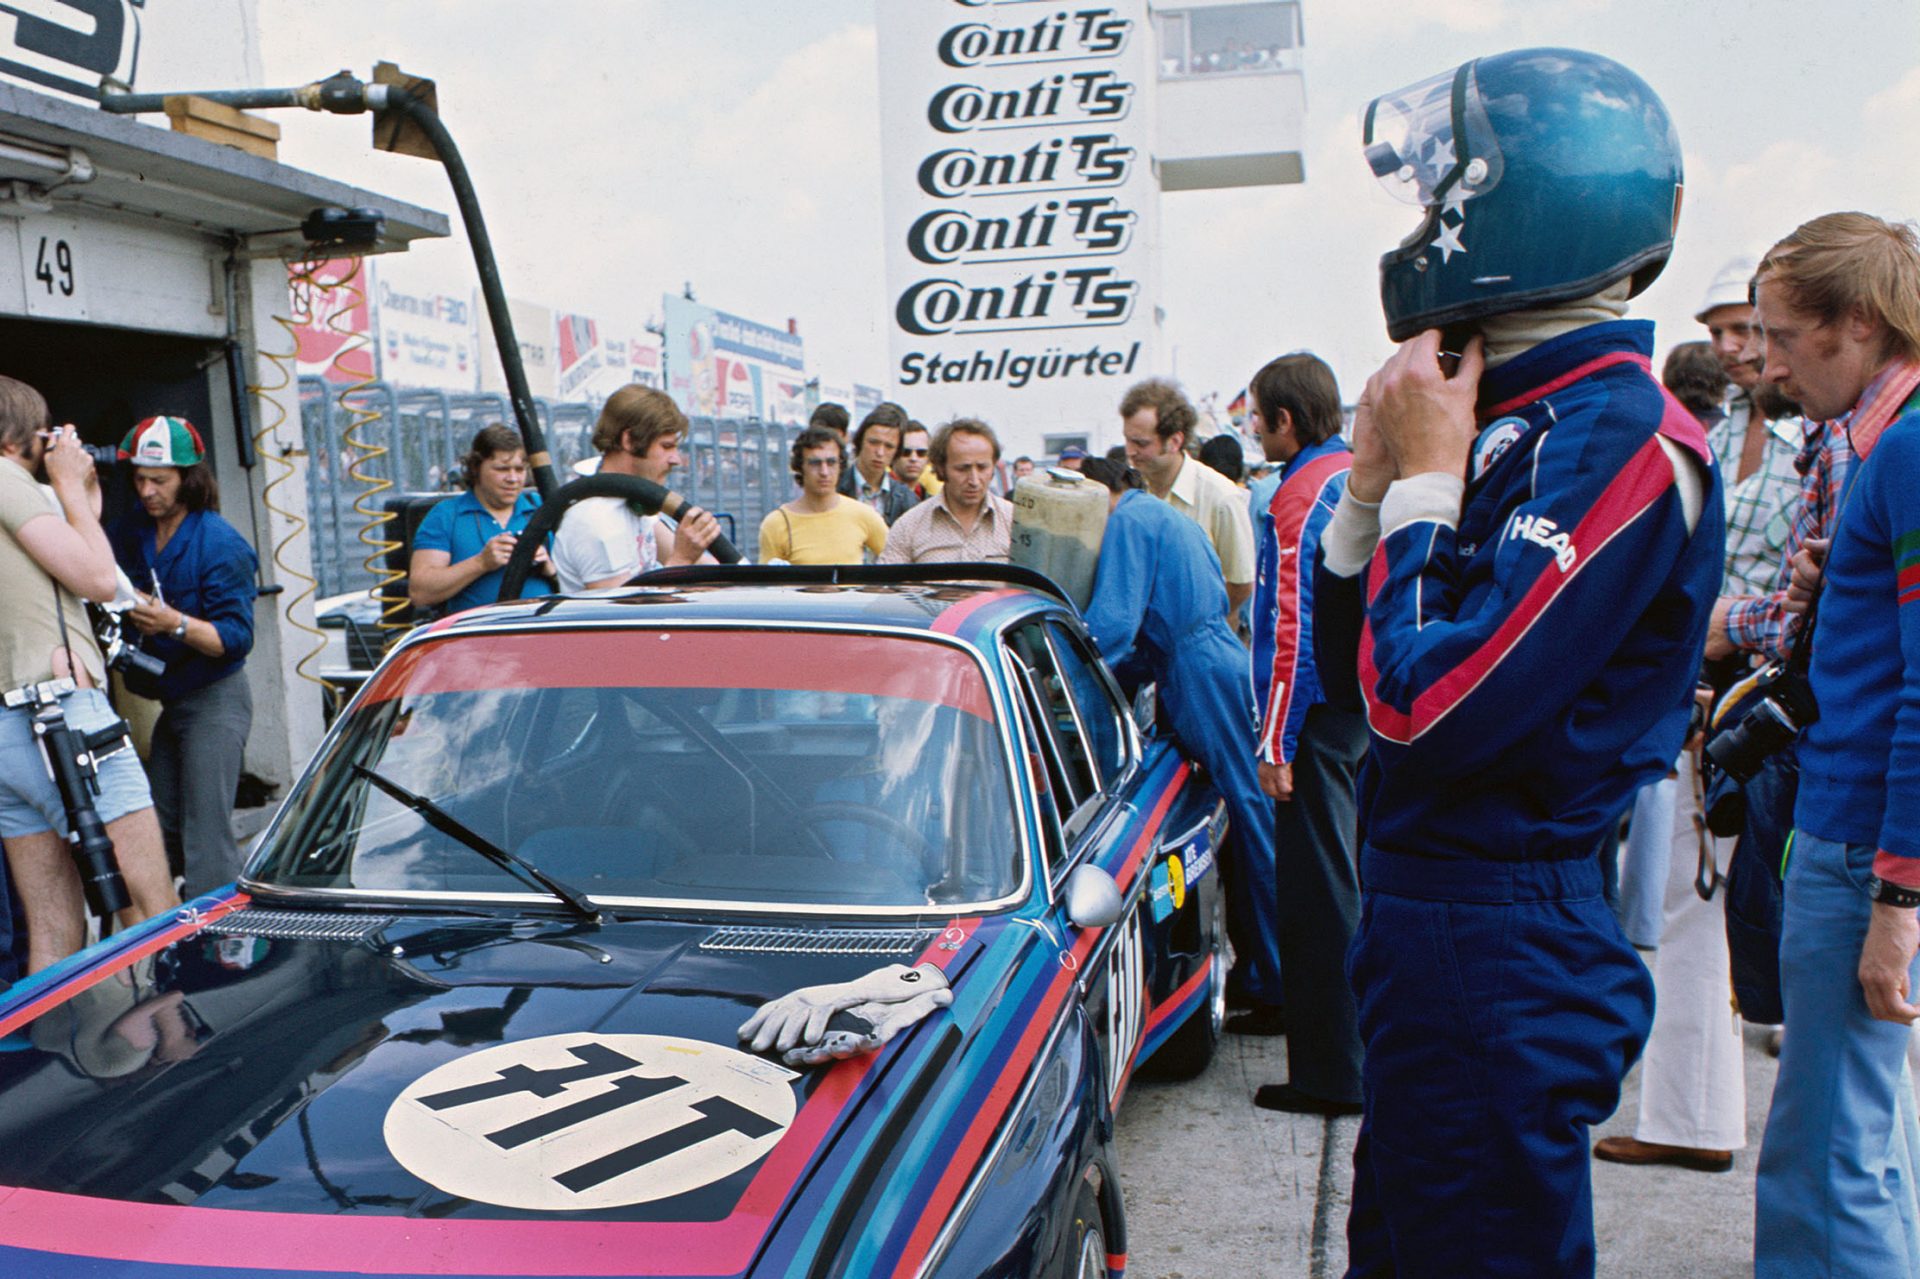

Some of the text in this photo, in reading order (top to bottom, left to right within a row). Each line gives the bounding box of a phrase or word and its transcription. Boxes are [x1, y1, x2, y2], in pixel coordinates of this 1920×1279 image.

[938, 9, 1133, 67] Conti TS
[927, 71, 1134, 134] Conti TS
[917, 134, 1135, 198] Conti TS
[907, 198, 1137, 265] Conti TS
[36, 236, 74, 296] 49
[896, 267, 1138, 336] Conti TS
[899, 342, 1141, 388] Stahlgürtel
[1509, 514, 1577, 573] HEAD
